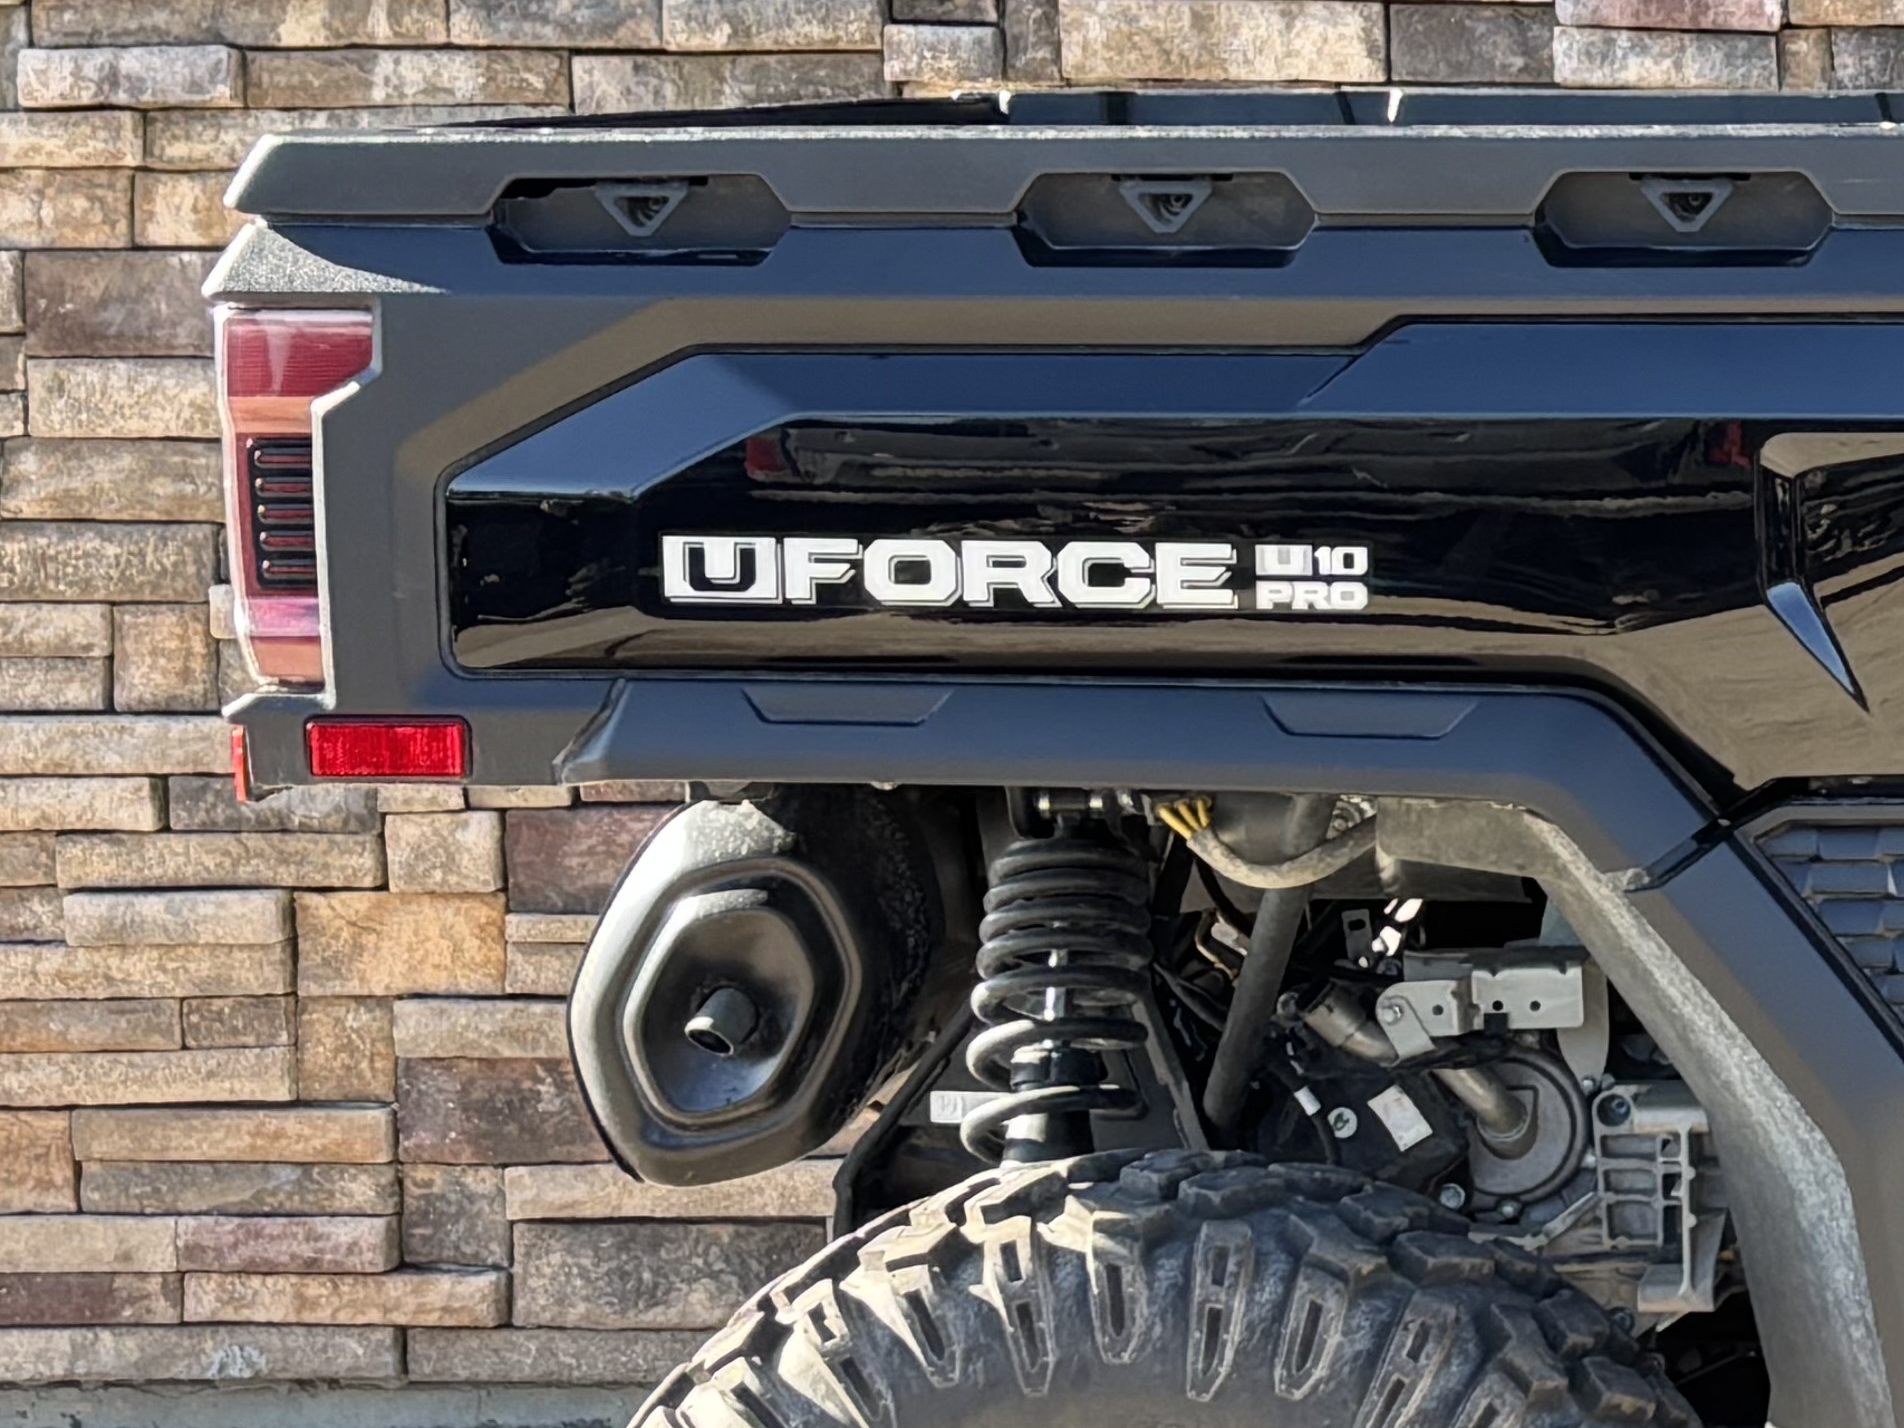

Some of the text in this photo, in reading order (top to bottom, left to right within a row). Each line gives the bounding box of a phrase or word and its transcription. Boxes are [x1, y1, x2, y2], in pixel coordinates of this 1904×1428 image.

[661, 535, 1239, 609] UFORCE
[1255, 545, 1368, 576] U10
[1255, 580, 1368, 610] PRO
